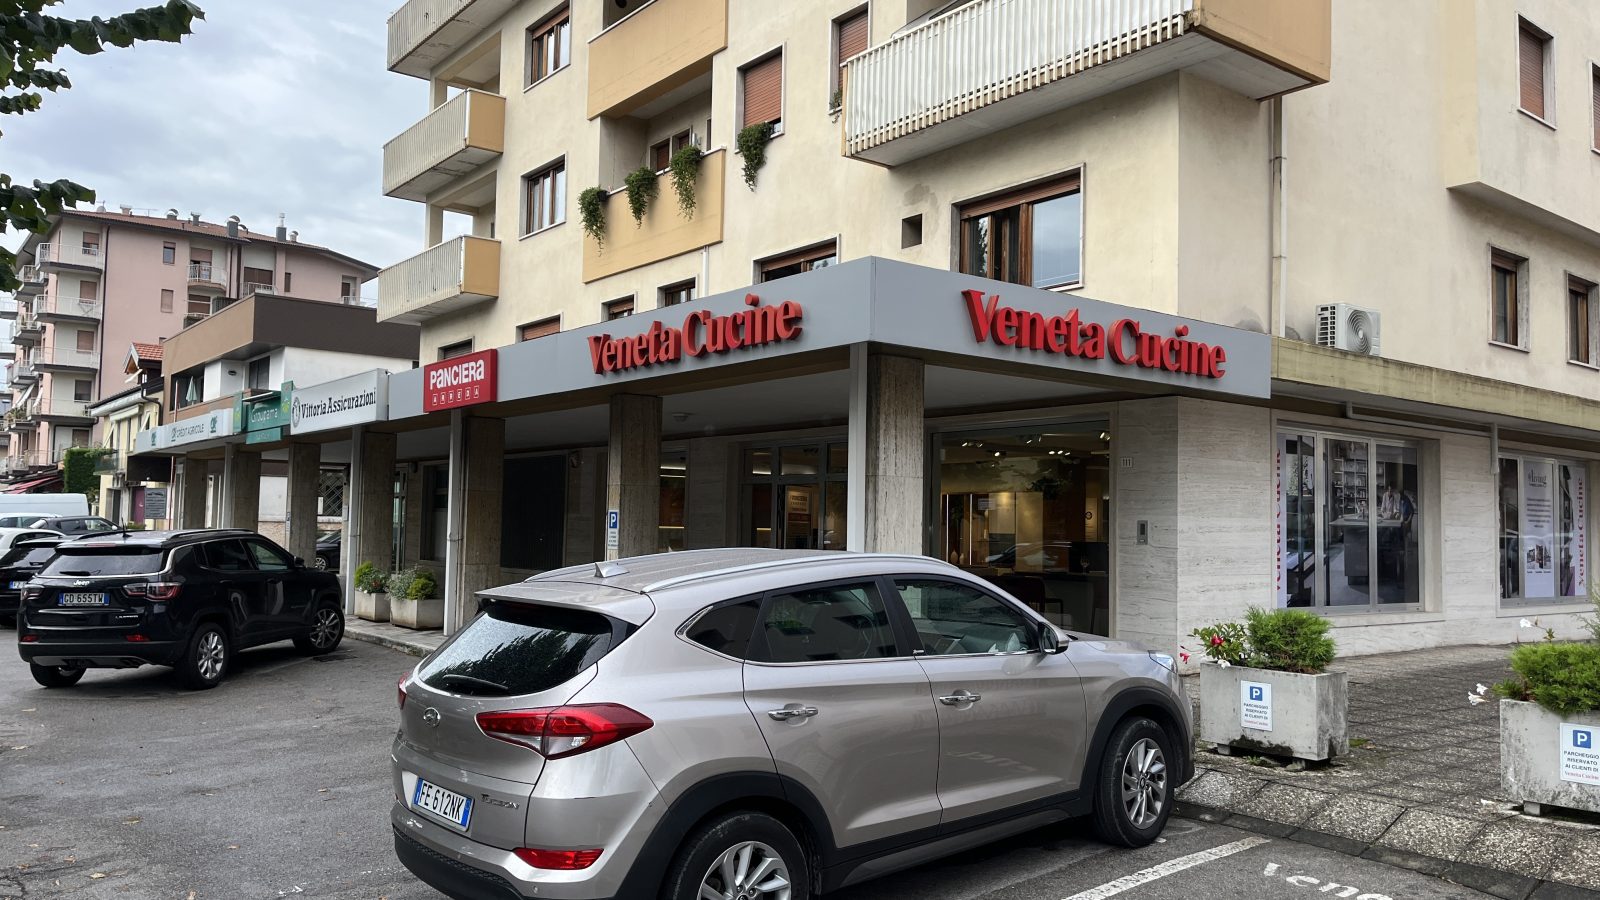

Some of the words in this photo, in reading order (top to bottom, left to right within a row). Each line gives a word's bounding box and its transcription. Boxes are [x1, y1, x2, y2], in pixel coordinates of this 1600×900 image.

[587, 321, 682, 375] Veneta
[682, 293, 803, 358] Cucine
[961, 288, 1105, 360] Veneta
[1106, 318, 1228, 379] Cucine
[301, 400, 327, 418] Vittoria
[327, 387, 377, 414] Assicurazioni
[433, 386, 479, 405] ARREDA
[610, 513, 617, 528] P
[1252, 688, 1260, 699] P
[1577, 732, 1587, 745] P
[1564, 750, 1599, 759] PARCHEGGIO
[1567, 757, 1598, 765] RISERVATO
[419, 783, 433, 807] FE
[432, 788, 465, 821] 612NK
